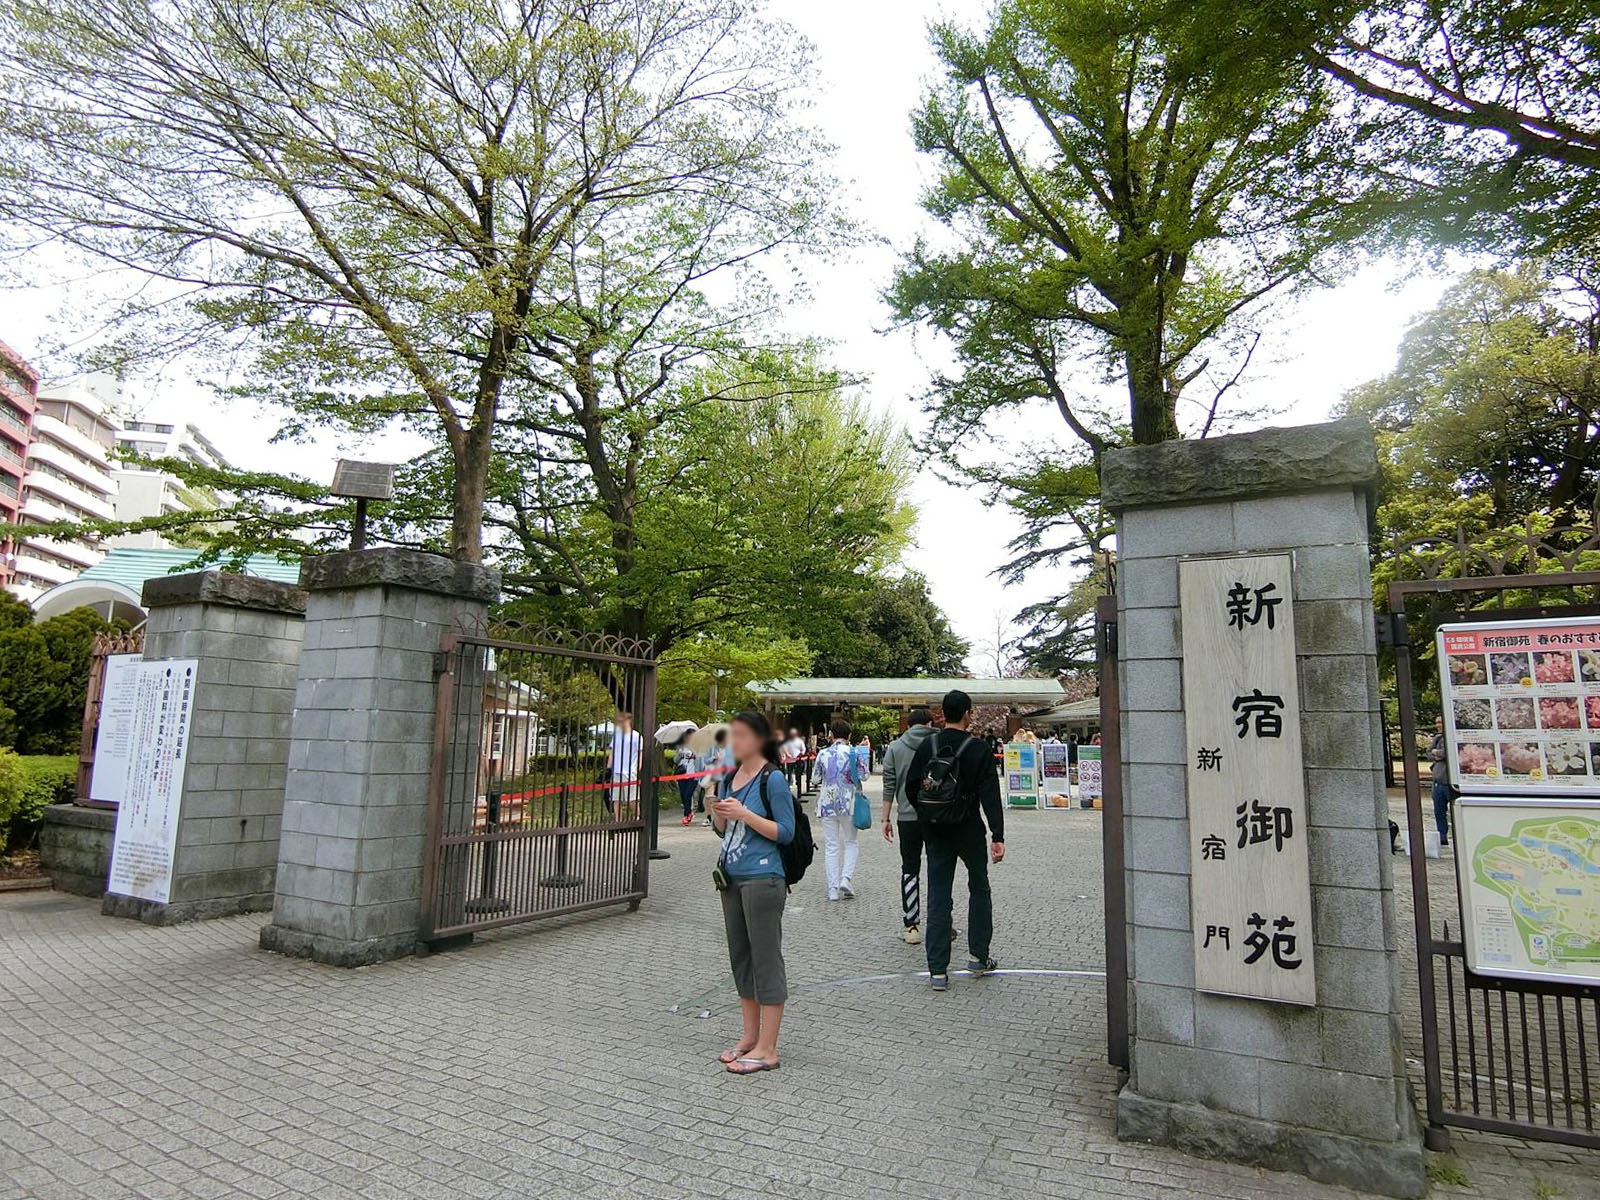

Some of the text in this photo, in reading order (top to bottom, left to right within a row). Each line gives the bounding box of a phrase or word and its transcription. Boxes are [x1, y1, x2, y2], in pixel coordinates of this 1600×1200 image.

[1483, 631, 1600, 648] 新宿御苑 春のおすす
[1196, 746, 1230, 952] 新宿門
[1226, 582, 1303, 970] 新宿御苑
